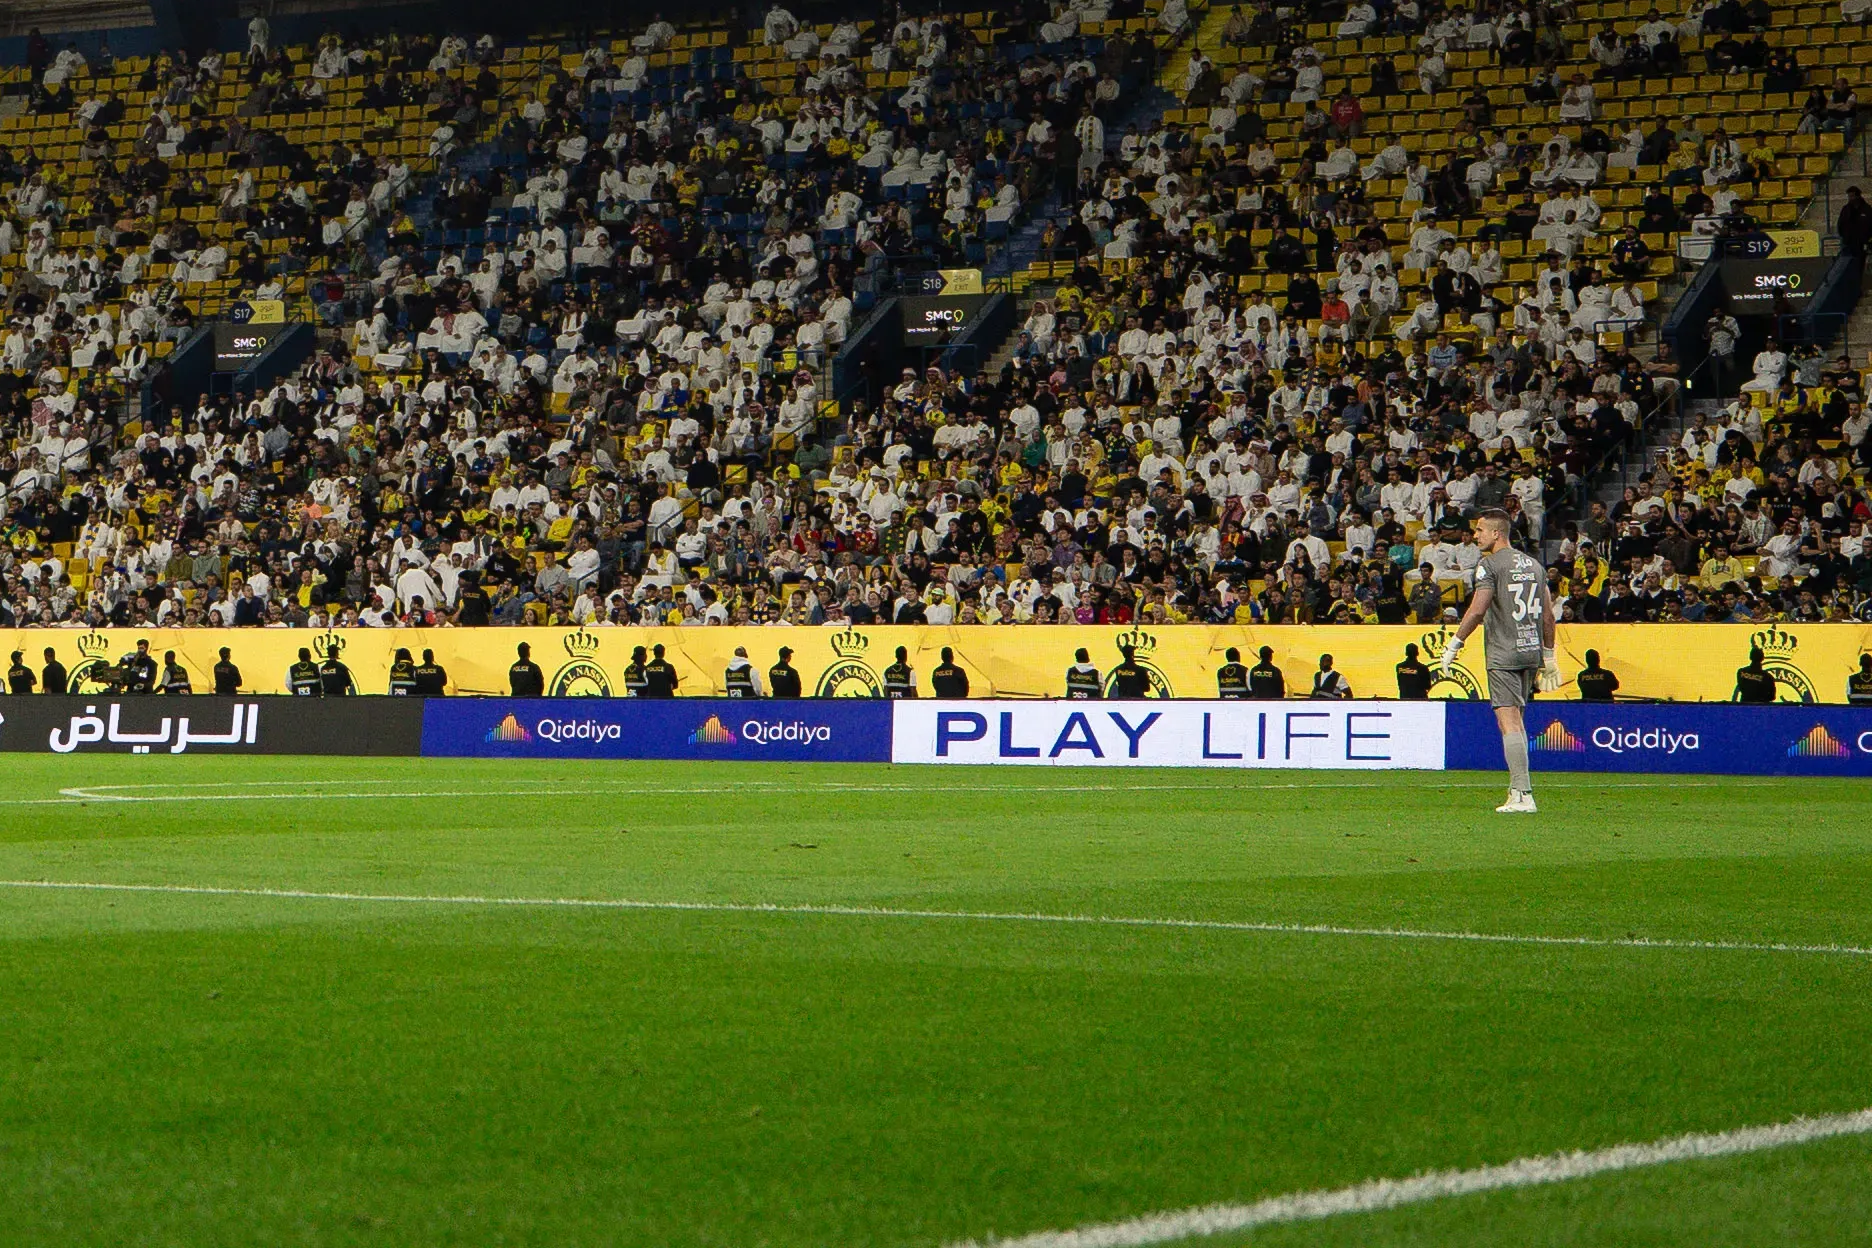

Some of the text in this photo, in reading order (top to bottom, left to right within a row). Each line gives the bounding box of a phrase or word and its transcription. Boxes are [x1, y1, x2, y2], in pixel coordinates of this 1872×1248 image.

[1747, 240, 1803, 255] S19 EXIT
[922, 278, 942, 290] S18
[1755, 275, 1787, 287] SMC
[234, 308, 250, 319] S17
[925, 310, 952, 322] SMC
[233, 337, 257, 349] SMC
[1507, 583, 1543, 621] 34
[563, 666, 606, 690] AL NASSR
[829, 666, 877, 690] AL NASSR
[1253, 670, 1273, 678] POLICE
[1581, 673, 1605, 681] POLICE
[1740, 671, 1763, 682] POLICE
[48, 703, 259, 754] الرياض
[537, 718, 621, 744] Qiddiya
[742, 720, 831, 745] Qiddiya
[935, 711, 1392, 761] PLAY LIFE
[1592, 726, 1700, 754] Qiddiya
